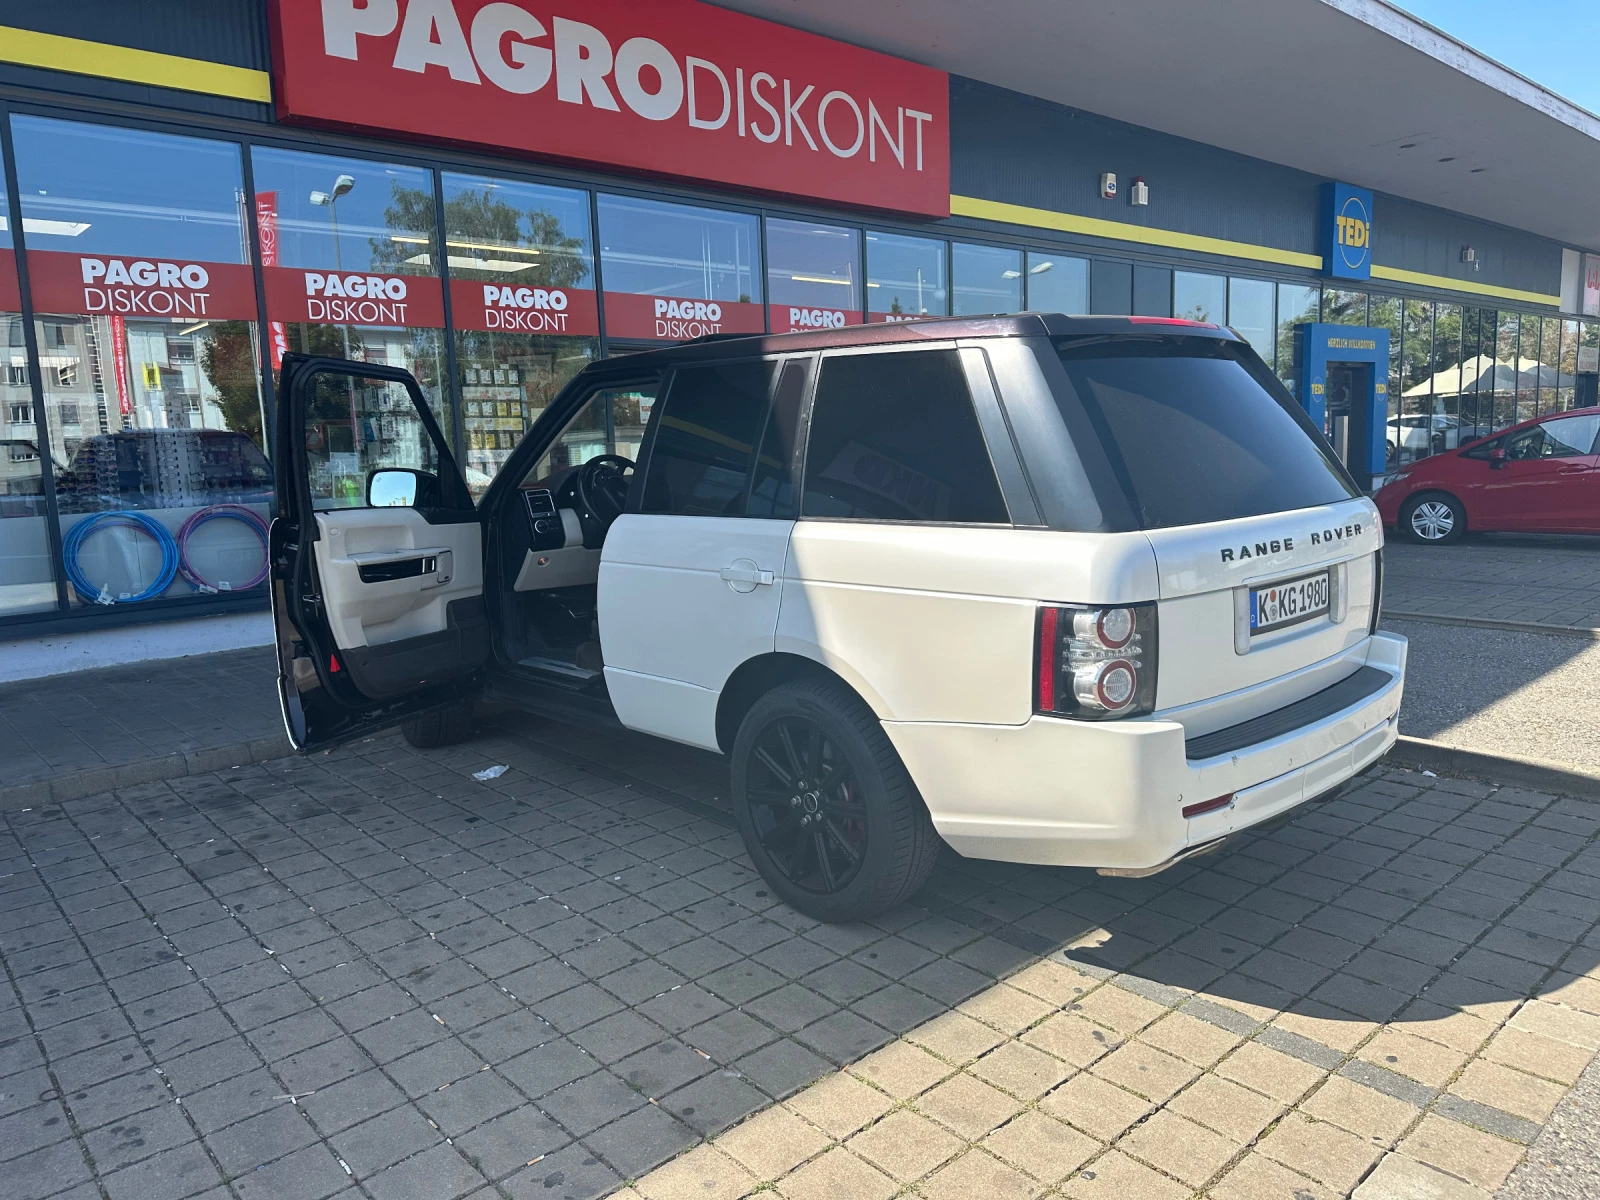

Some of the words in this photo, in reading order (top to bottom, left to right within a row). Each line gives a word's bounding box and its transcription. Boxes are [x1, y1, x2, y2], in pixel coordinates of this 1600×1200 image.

[1336, 215, 1370, 249] TEDi
[80, 257, 209, 289] PAGRO
[304, 272, 407, 301] PAGRO
[483, 285, 568, 311] PAGRO
[84, 287, 210, 315] DISKONT
[307, 299, 408, 323] DISKONT
[654, 298, 722, 322] PAGRO
[485, 309, 569, 332] DISKONT
[655, 320, 722, 339] DISKONT
[789, 307, 846, 328] PAGRO
[1220, 537, 1294, 563] RANGE
[1310, 523, 1363, 546] ROVER
